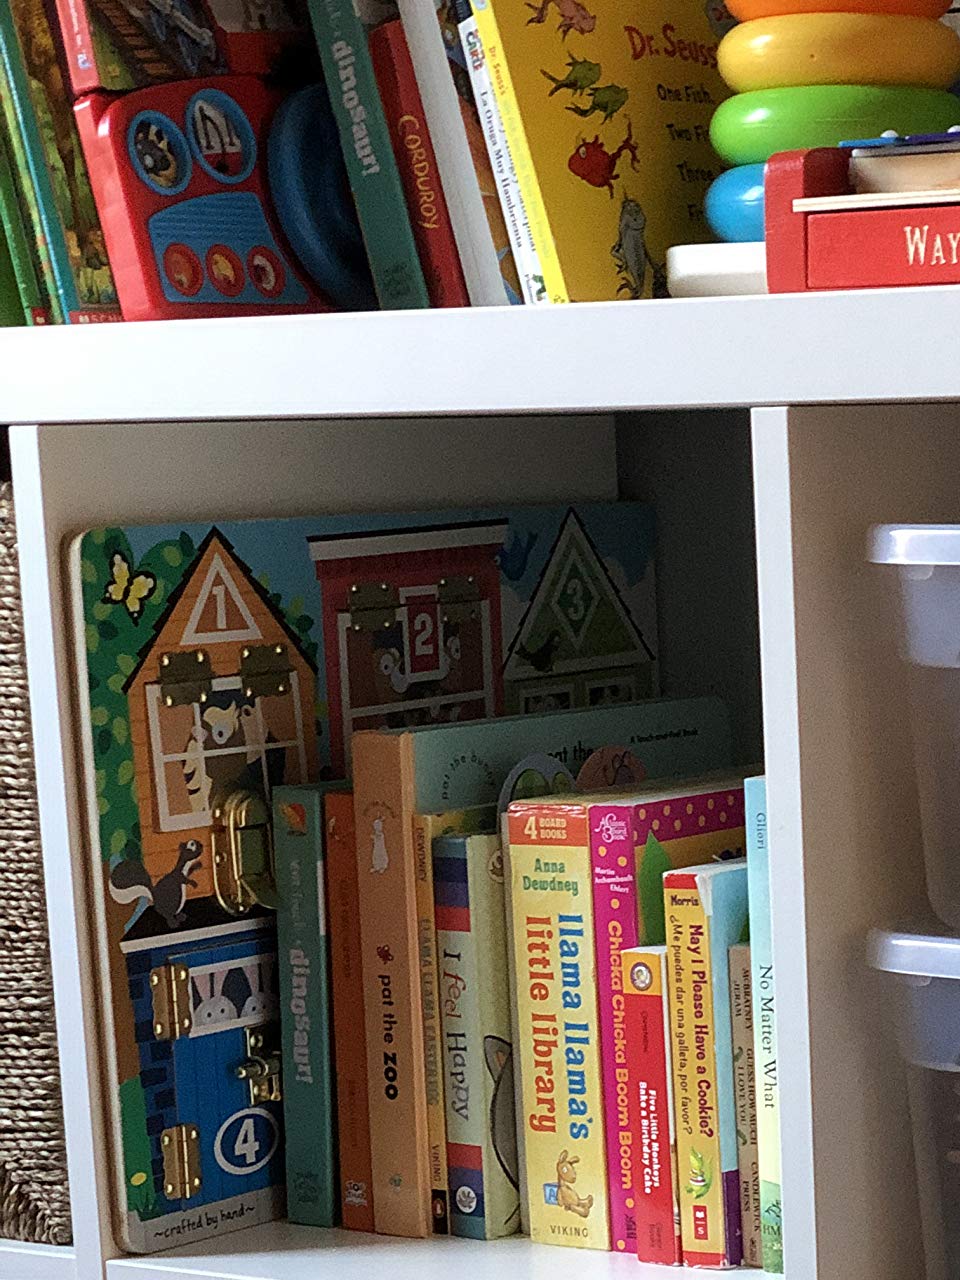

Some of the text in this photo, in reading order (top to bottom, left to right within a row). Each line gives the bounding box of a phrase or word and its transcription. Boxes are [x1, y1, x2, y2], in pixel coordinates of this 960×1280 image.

[624, 23, 719, 69] Dr. Seuss
[332, 39, 380, 178] dinosaur!
[657, 84, 682, 101] One
[666, 123, 709, 142] Two Fi
[398, 114, 440, 230] CORDUROY
[485, 109, 498, 147] Oruga
[494, 149, 506, 174] Muy
[501, 178, 523, 248] Hambrienta
[212, 585, 228, 630] 1
[566, 579, 586, 621] 3
[414, 612, 434, 657] 2
[547, 746, 568, 763] at
[524, 816, 538, 839] 4
[539, 818, 567, 828] BOARD
[539, 829, 568, 840] BOOKS
[534, 858, 566, 873] Anna
[522, 875, 579, 896] Dewdney
[670, 893, 699, 907] Morris
[669, 914, 683, 943] ¿Me
[687, 924, 703, 955] May
[672, 945, 686, 983] puedes
[376, 974, 398, 1011] pat
[676, 986, 689, 1005] dar
[692, 969, 709, 1020] Please
[288, 948, 315, 1085] dinosaur!
[380, 1012, 399, 1044] the
[526, 915, 559, 1135] little library
[558, 913, 590, 1141] llama llama's
[677, 1007, 688, 1030] una
[442, 949, 470, 1122] I feel Happy
[695, 1023, 711, 1062] Have
[759, 964, 778, 1109] No Matter What
[608, 920, 632, 1190] Chicka Chicka Boom Boom
[697, 1066, 707, 1075] a
[638, 1080, 649, 1109] Bake
[678, 1074, 691, 1094] por
[737, 1070, 746, 1101] LOVE
[747, 1047, 758, 1146] GUESS HOW MUCH
[680, 1096, 694, 1135] favor?
[697, 1079, 714, 1138] Cookie?
[739, 1102, 748, 1126] YOU
[234, 1118, 260, 1164] 4
[639, 1118, 652, 1167] Birthday
[648, 1089, 662, 1188] Five Little Monkeys
[431, 1144, 441, 1182] VIKING
[643, 1168, 653, 1195] Cake
[742, 1180, 751, 1213] PRESS
[205, 1212, 218, 1229] by
[550, 1225, 590, 1239] VIKING
